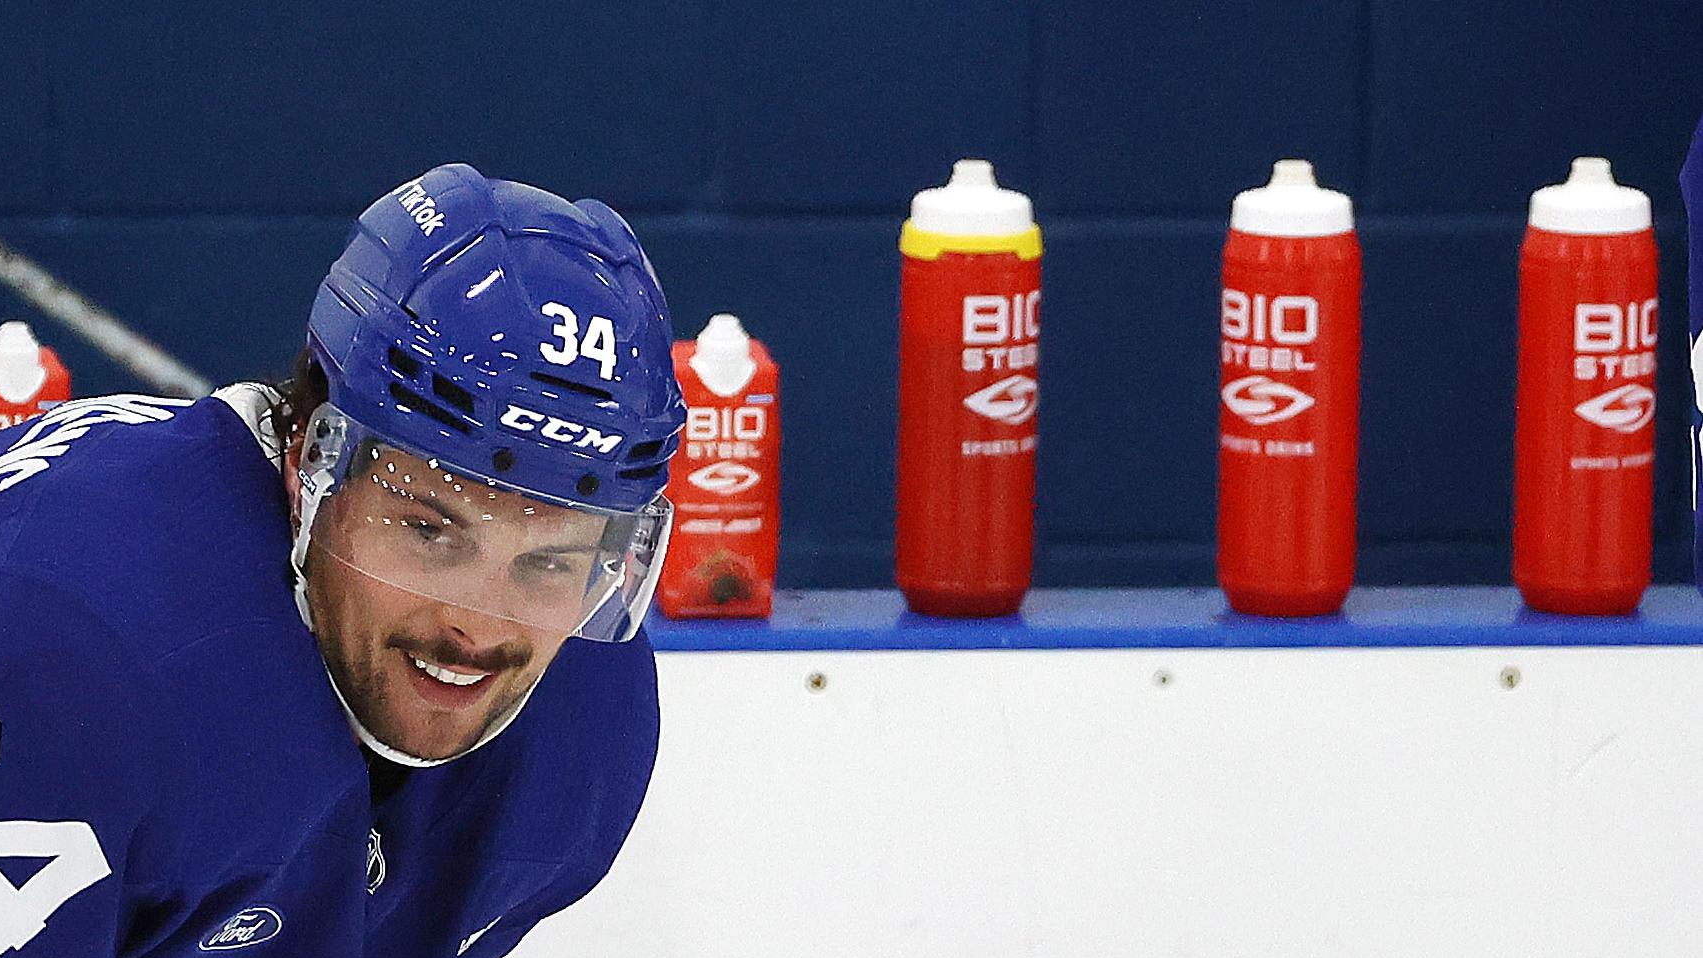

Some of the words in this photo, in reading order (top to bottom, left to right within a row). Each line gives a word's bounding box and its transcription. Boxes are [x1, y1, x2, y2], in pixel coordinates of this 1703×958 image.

[398, 184, 445, 237] TikTok
[539, 301, 618, 381] 34
[1222, 288, 1319, 345] BIO
[499, 403, 625, 454] CCM
[686, 407, 766, 440] BIO
[209, 914, 266, 945] Ford
